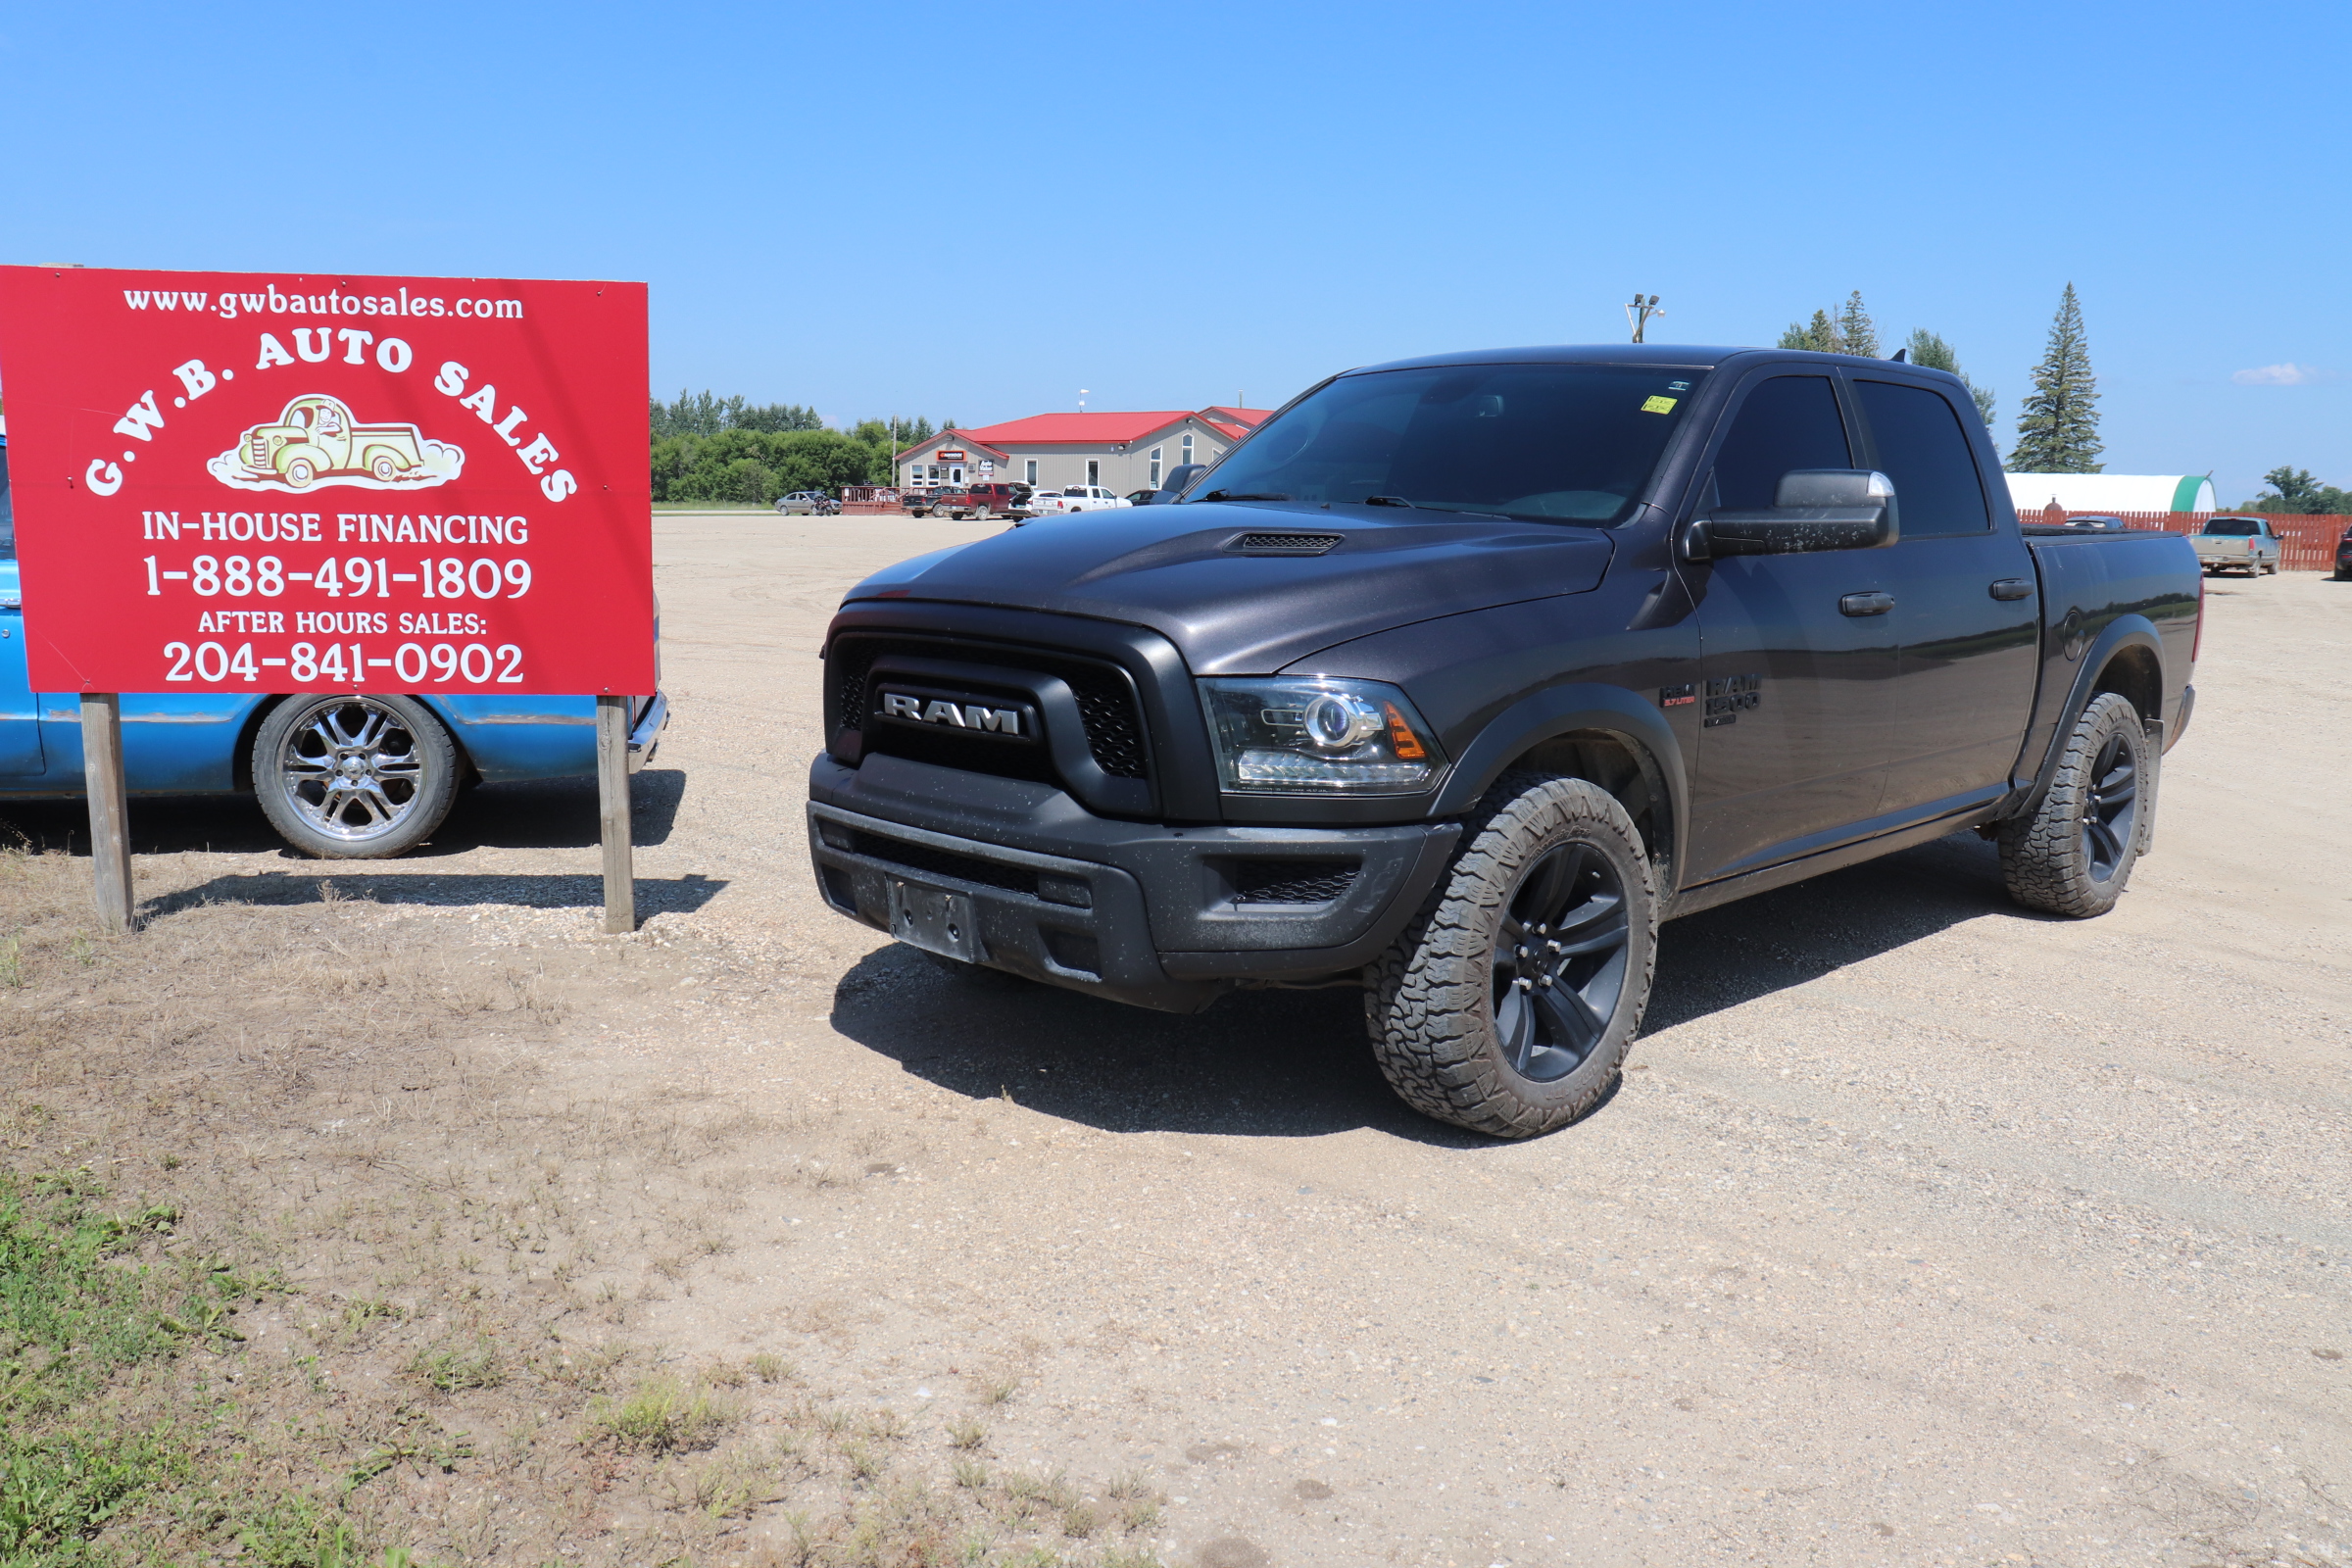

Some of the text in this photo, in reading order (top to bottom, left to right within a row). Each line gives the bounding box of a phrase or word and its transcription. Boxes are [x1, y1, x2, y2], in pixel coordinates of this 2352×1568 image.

[122, 283, 524, 319] www.gwbautosales.com
[85, 326, 578, 503] G.W.B. AUTO SALES
[141, 511, 529, 545] IN-HOUSE FINANCING
[143, 555, 532, 600] 1-888-491-1809
[197, 611, 487, 636] AFTER HOURS SALES:
[163, 641, 524, 684] 204-841-0902
[1677, 696, 1695, 705] LITER
[1706, 673, 1763, 696] RAM
[884, 693, 1018, 735] RAM
[1706, 692, 1761, 715] 1500
